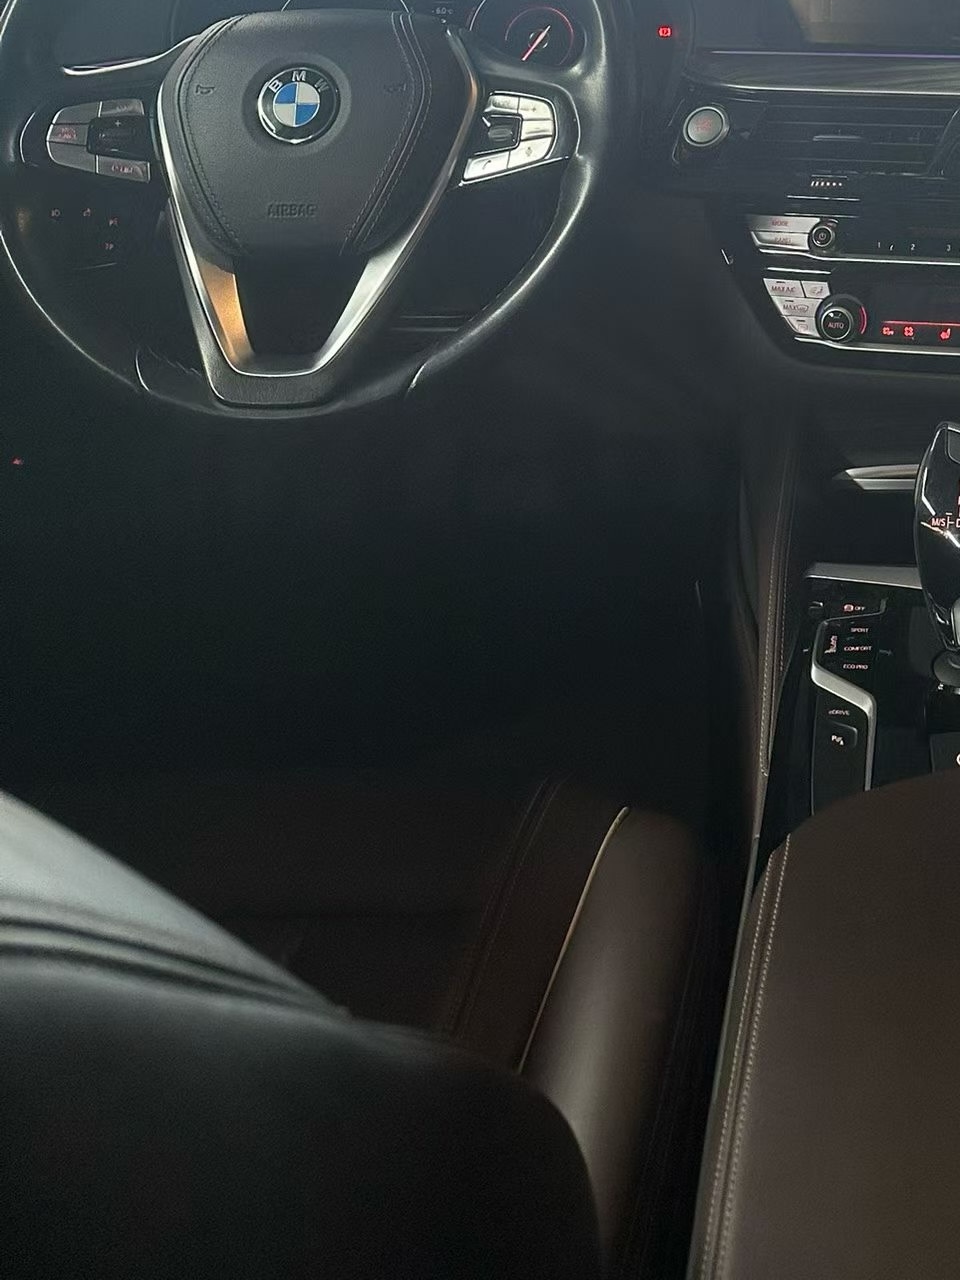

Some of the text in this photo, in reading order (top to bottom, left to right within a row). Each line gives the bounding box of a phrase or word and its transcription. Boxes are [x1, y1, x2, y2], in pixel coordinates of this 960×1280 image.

[268, 69, 330, 93] BMW
[267, 203, 318, 219] AIRBAG
[931, 517, 946, 526] M/S
